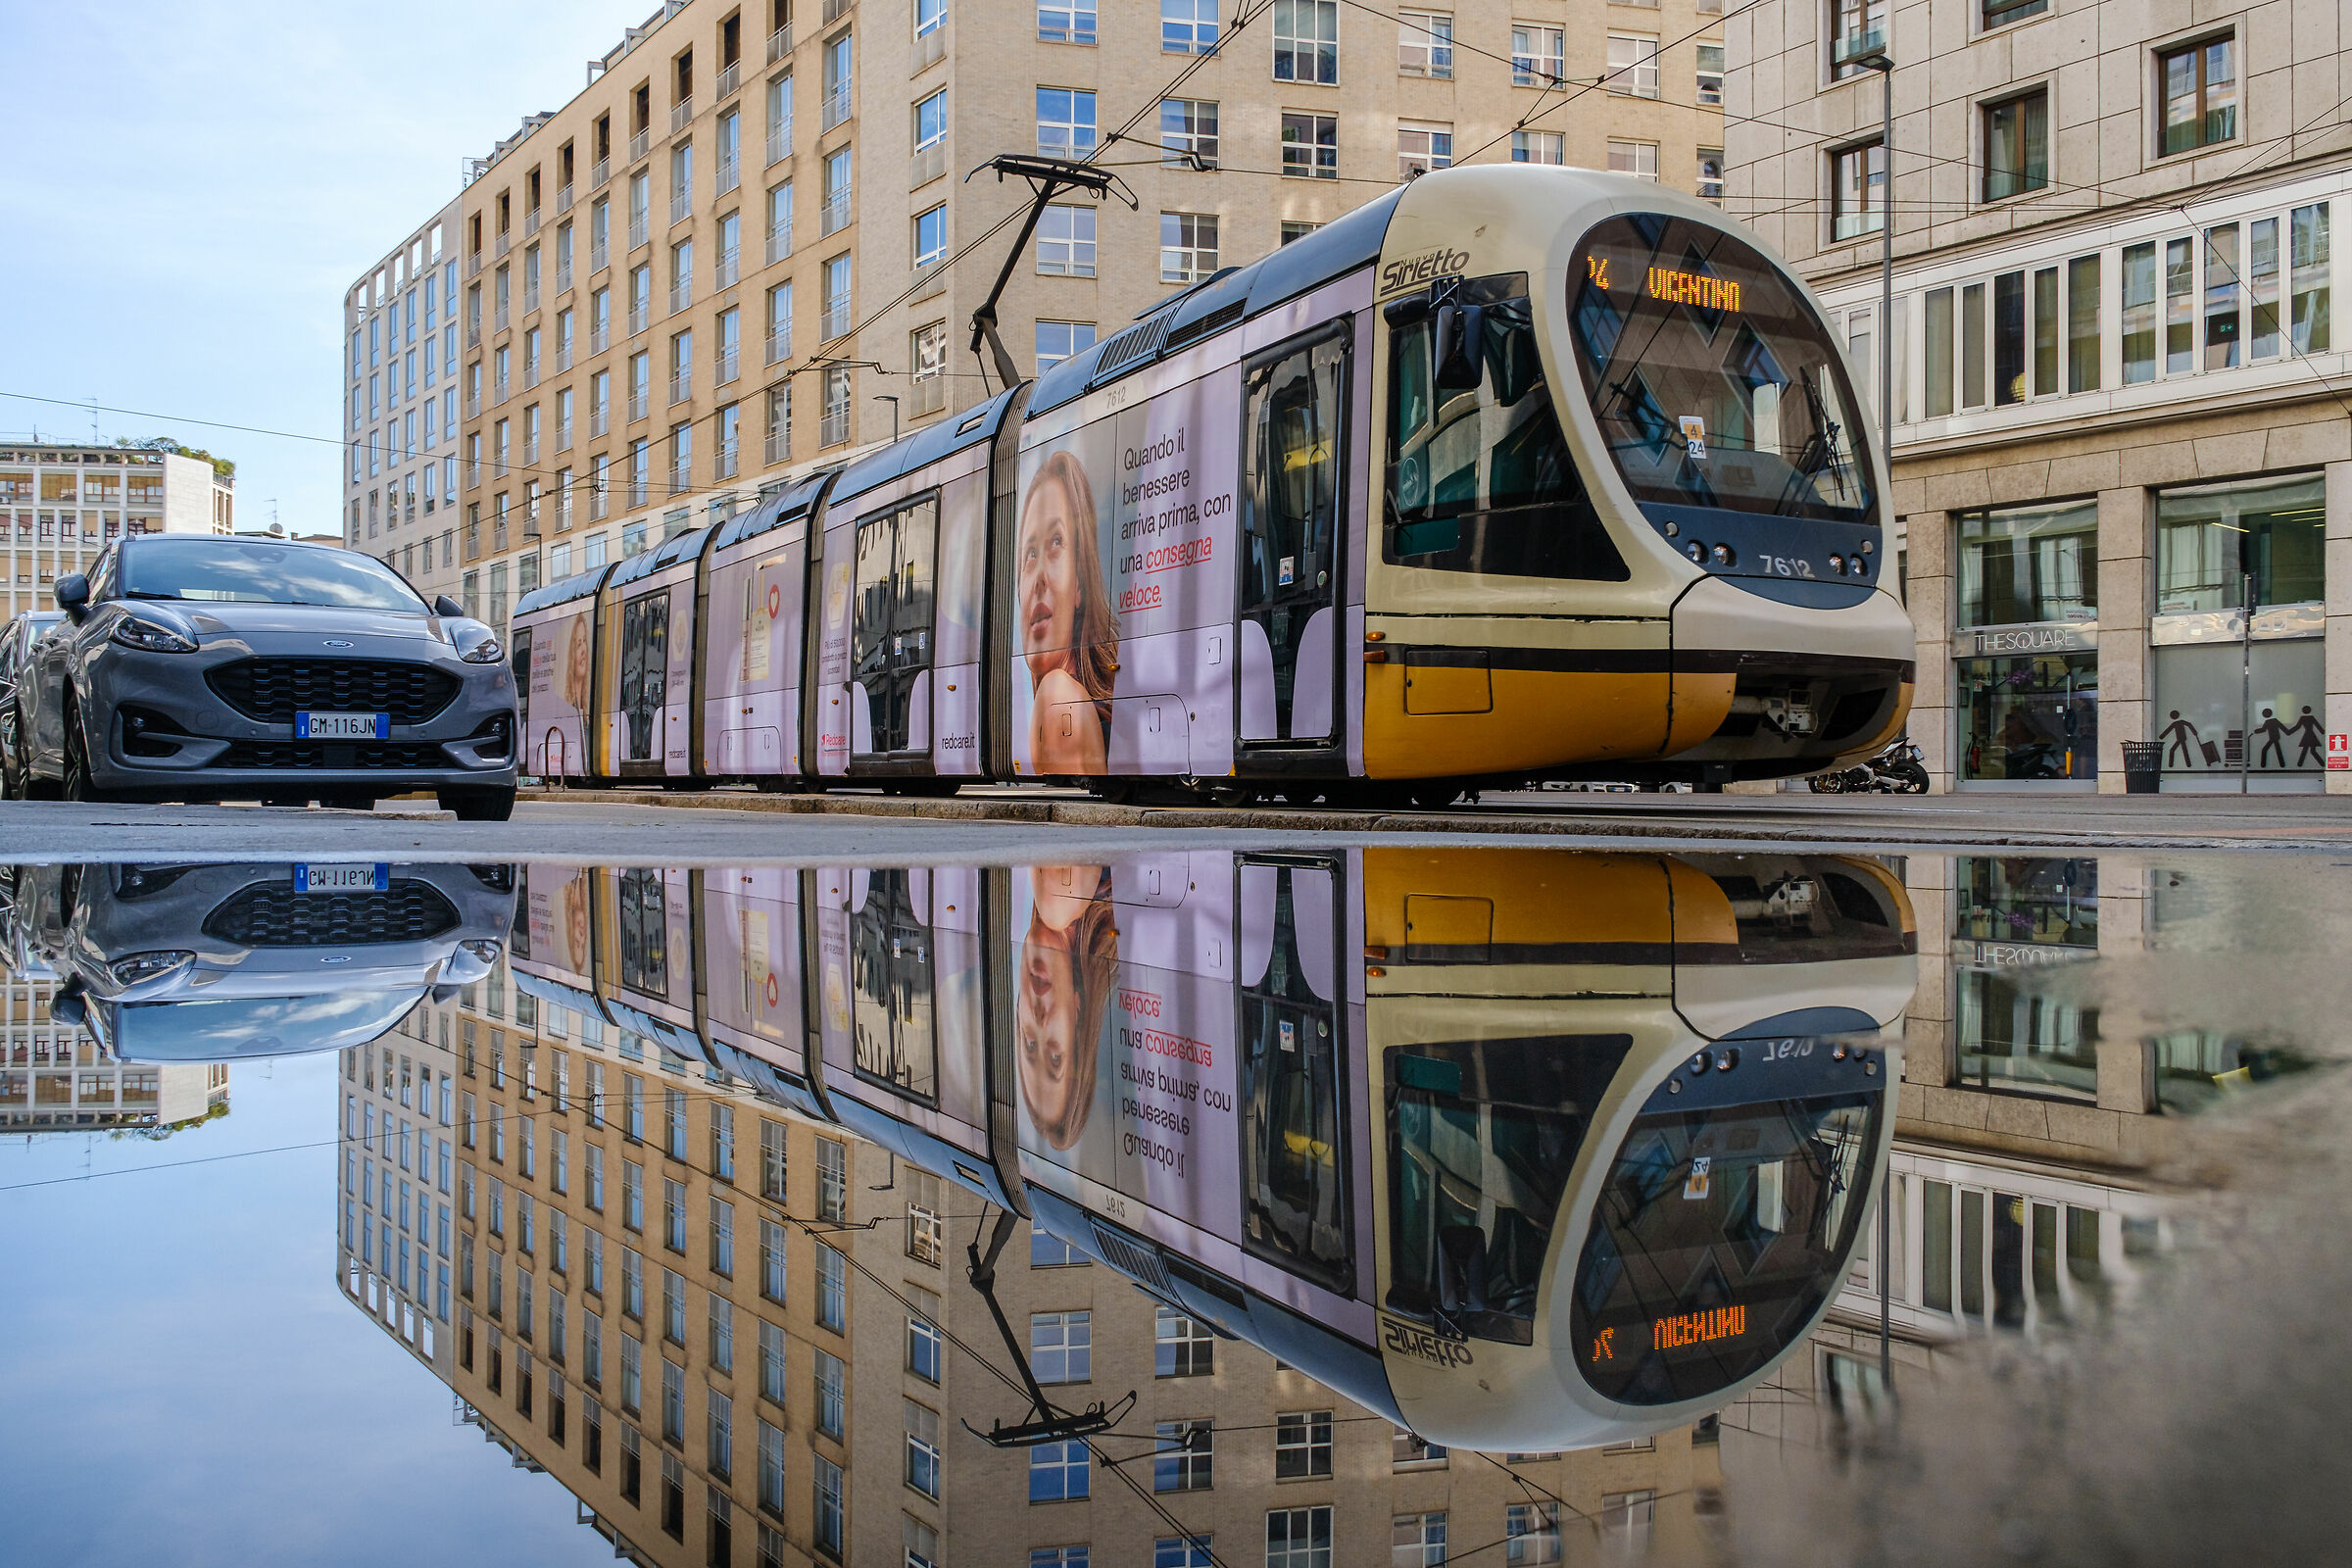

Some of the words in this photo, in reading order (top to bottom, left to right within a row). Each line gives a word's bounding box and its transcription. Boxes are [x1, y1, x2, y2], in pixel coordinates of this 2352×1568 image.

[1381, 248, 1470, 292] Sirietto
[1106, 385, 1126, 409] 7612
[1124, 434, 1174, 470] Quando
[1178, 427, 1185, 453] il
[1689, 441, 1704, 455] 24
[1123, 469, 1190, 506] benessere
[1121, 513, 1155, 540] arriva
[1158, 502, 1200, 537] prima,
[1204, 493, 1231, 517] con
[1120, 554, 1143, 574] una
[1146, 536, 1211, 569] consegna
[1758, 555, 1816, 578] 7612
[1119, 582, 1161, 610] veloce.
[942, 731, 975, 750] redcare.it
